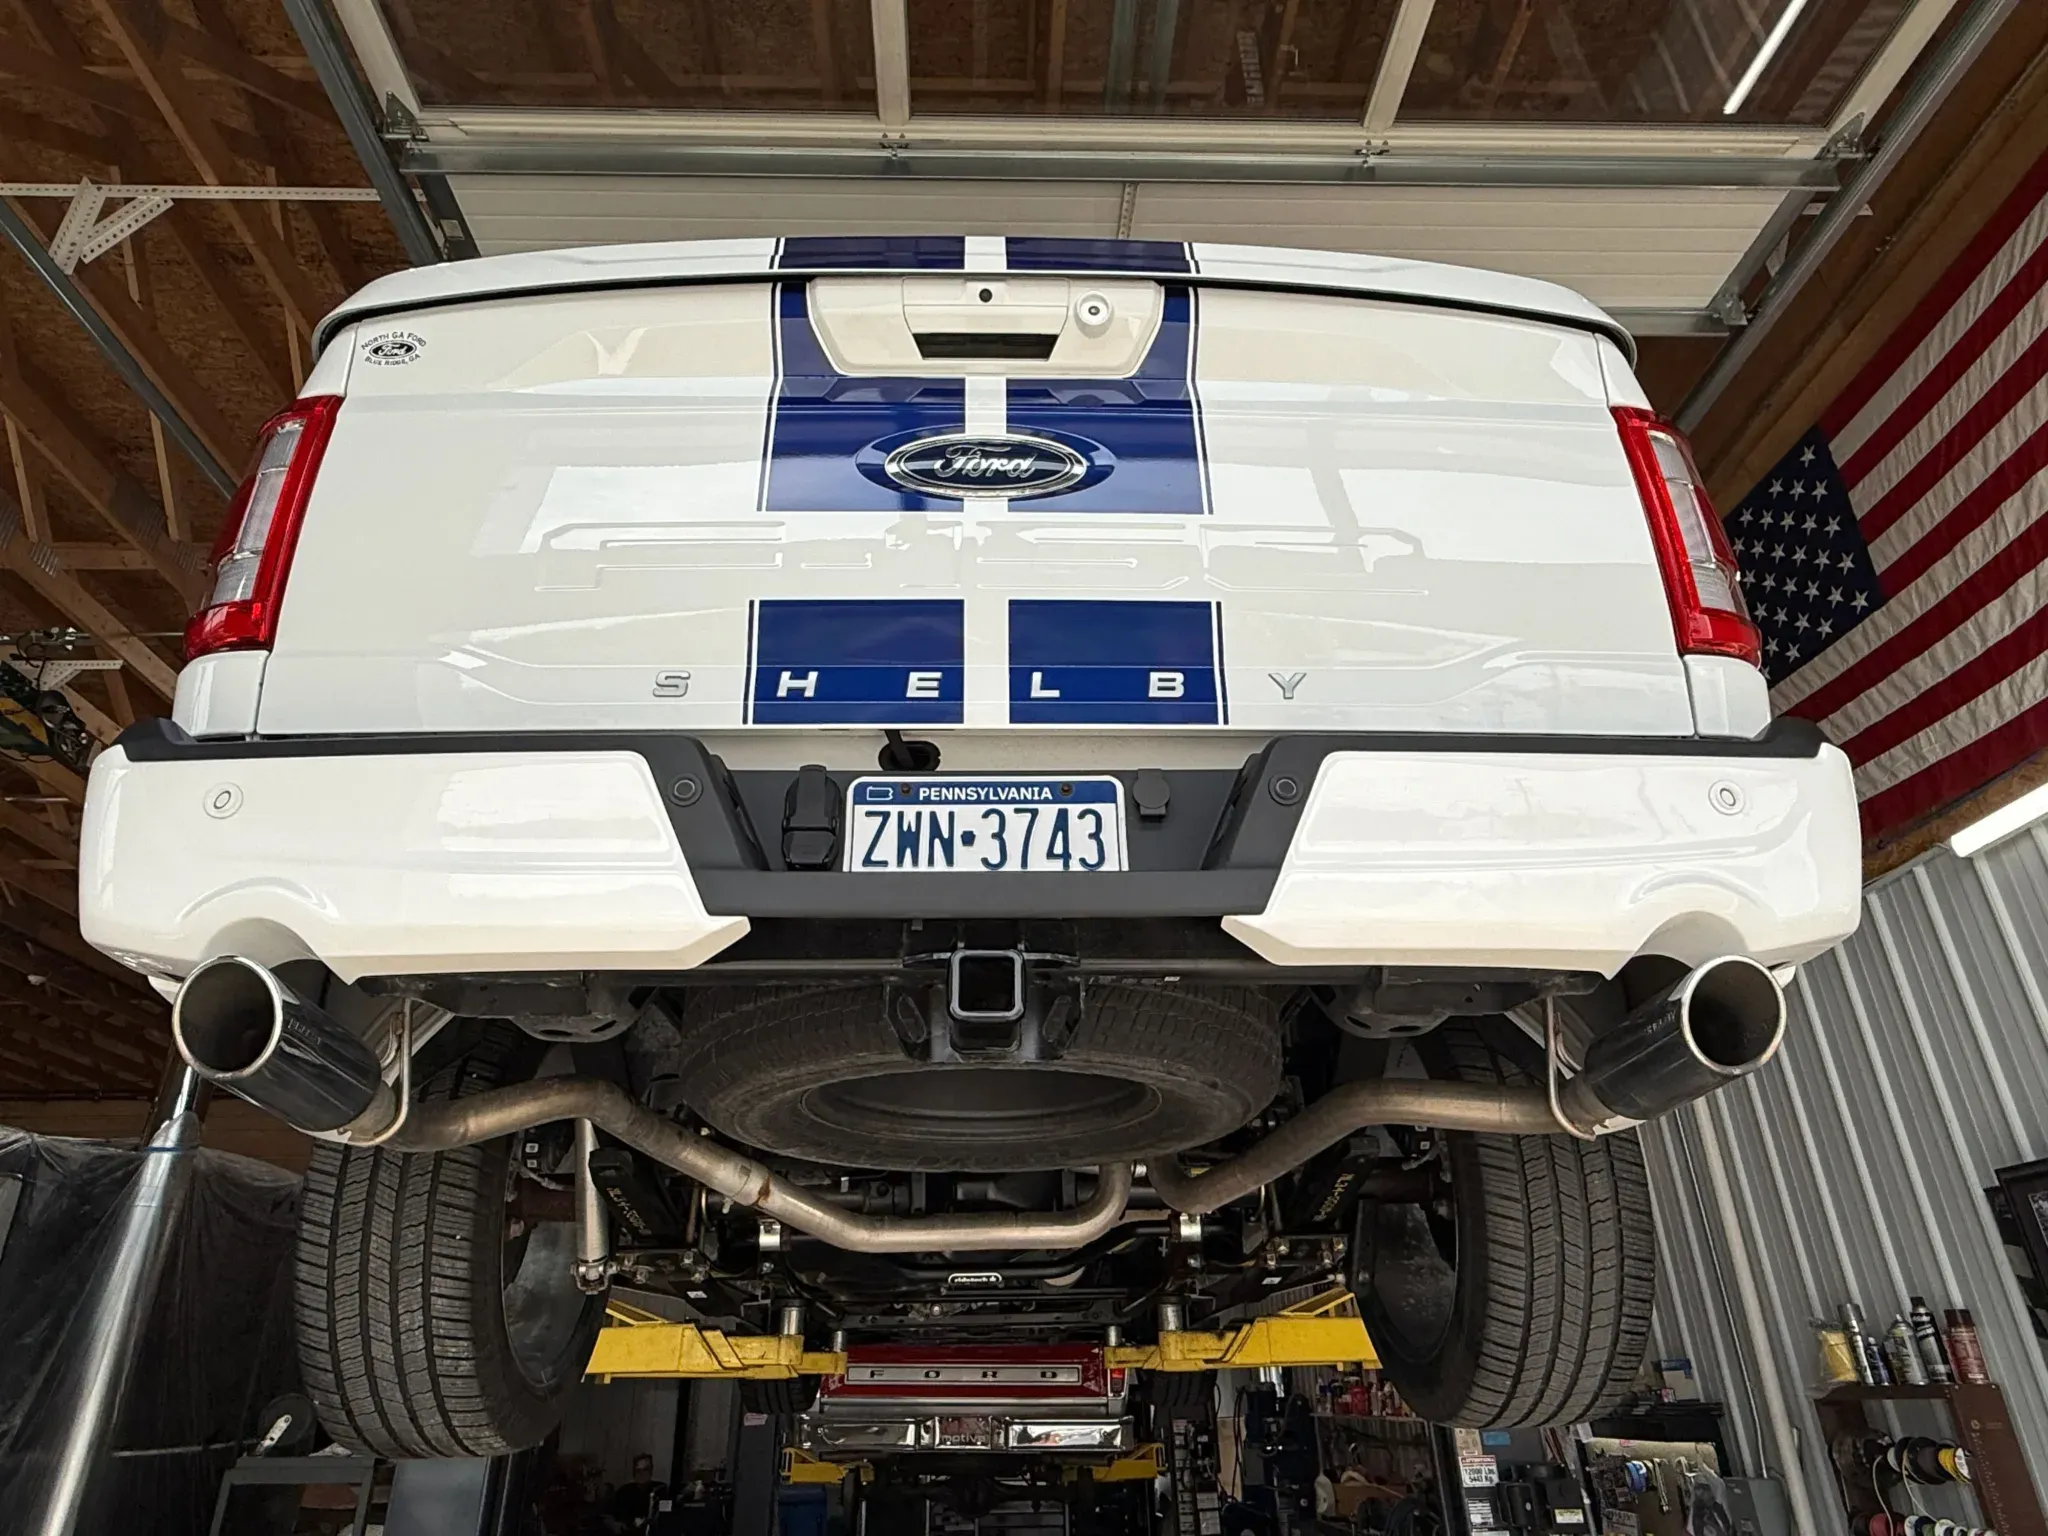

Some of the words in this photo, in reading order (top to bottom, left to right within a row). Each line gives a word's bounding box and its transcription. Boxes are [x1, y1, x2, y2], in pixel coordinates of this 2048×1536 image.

[361, 333, 390, 350] NORTH
[392, 331, 405, 340] GA
[407, 332, 427, 347] FORD
[378, 343, 408, 356] Ford
[365, 356, 382, 366] BLUE
[409, 354, 421, 362] GA
[934, 443, 1037, 479] Ford
[652, 670, 1308, 700] SHELBY
[919, 786, 1053, 801] PENNSYLVANIA
[870, 1370, 1058, 1379] FORD
